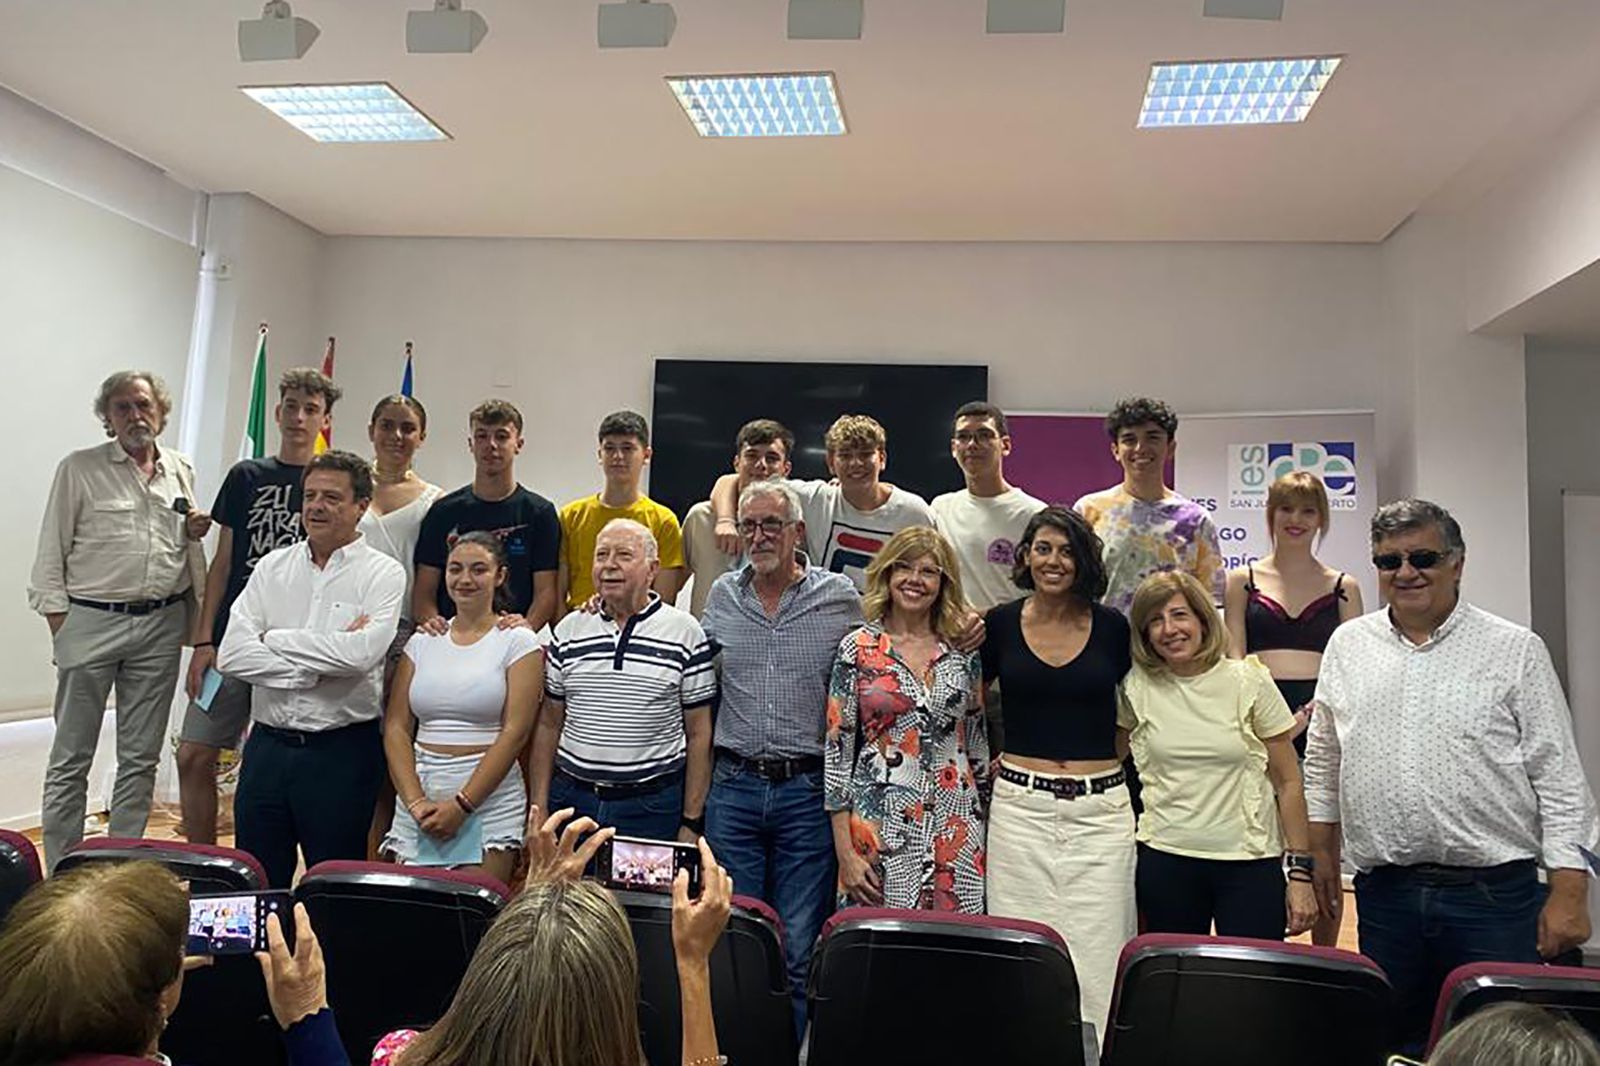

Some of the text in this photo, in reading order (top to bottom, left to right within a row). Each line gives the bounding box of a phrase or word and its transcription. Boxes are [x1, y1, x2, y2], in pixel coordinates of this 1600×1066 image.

[253, 484, 292, 510] ZU
[1230, 499, 1356, 508] SAN JU RTO
[1191, 498, 1217, 511] ES
[246, 508, 302, 536] ZARA
[1219, 527, 1247, 541] GO
